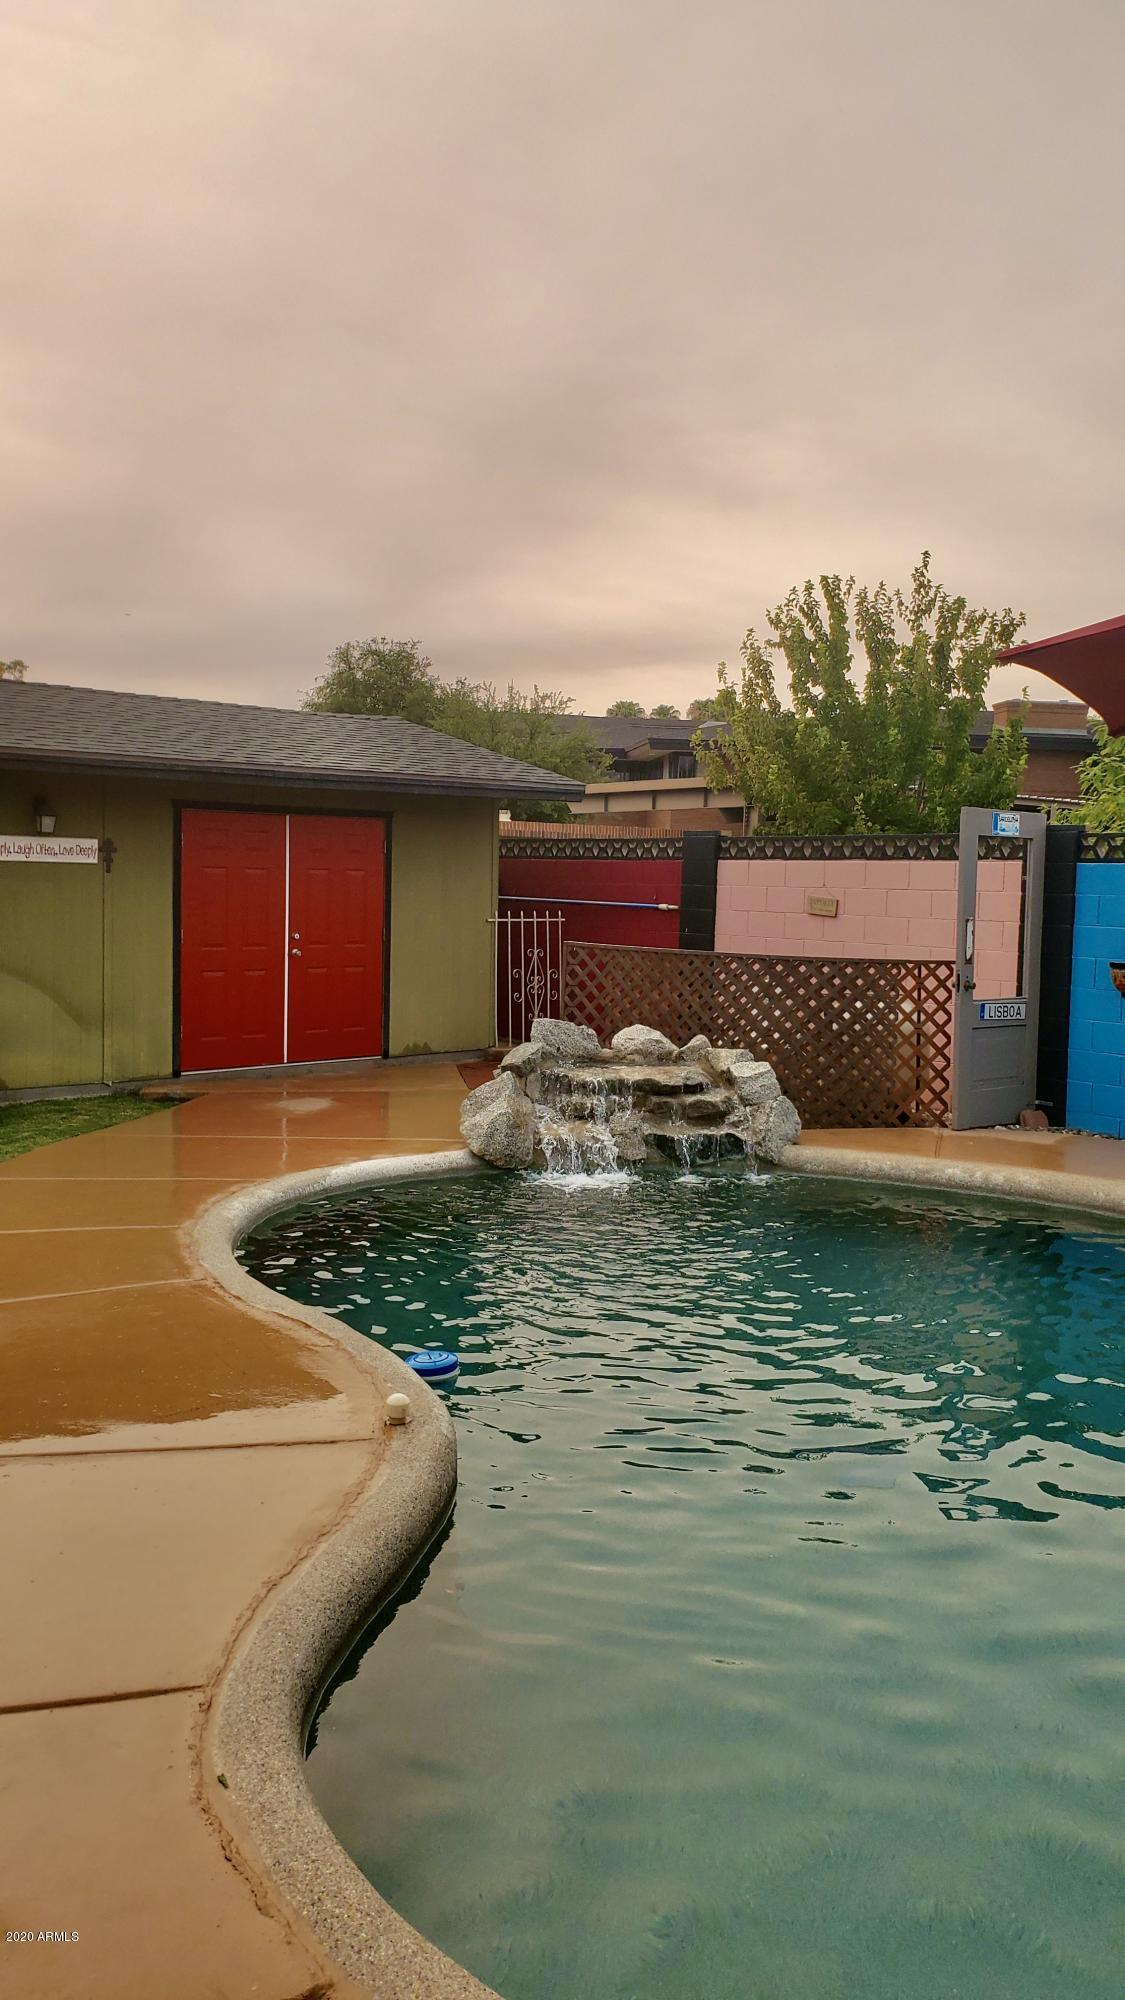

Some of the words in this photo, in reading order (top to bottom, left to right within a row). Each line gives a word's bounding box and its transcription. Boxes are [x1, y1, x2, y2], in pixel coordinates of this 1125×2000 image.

[13, 842, 34, 858] Laugh
[59, 844, 74, 856] Love
[75, 845, 97, 859] Deeply
[988, 1005, 1022, 1018] LISBOA
